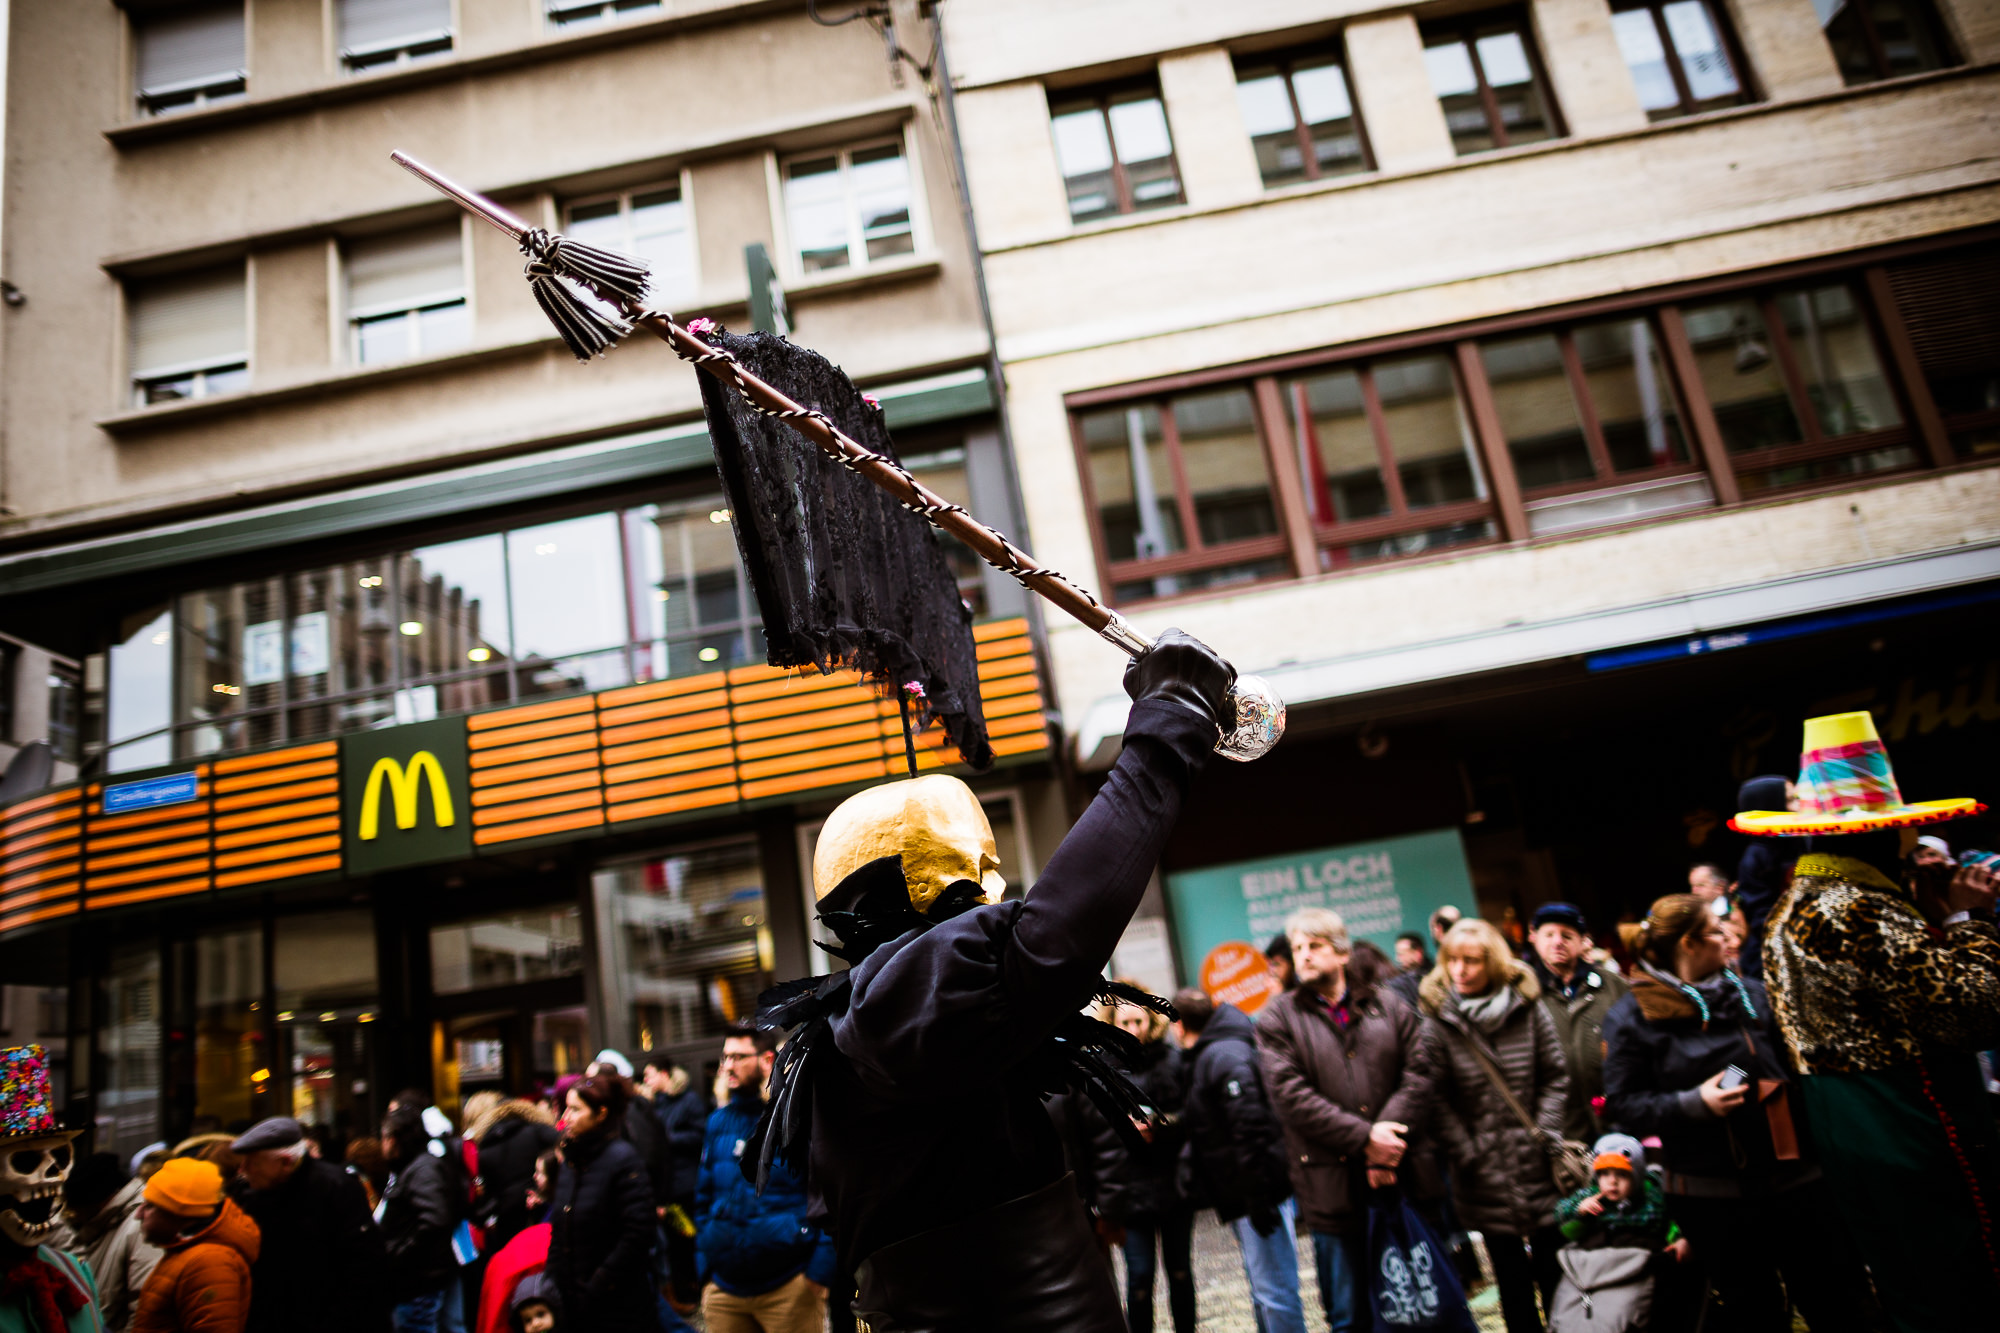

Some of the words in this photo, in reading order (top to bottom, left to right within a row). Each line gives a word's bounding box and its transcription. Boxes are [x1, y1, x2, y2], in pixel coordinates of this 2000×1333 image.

[359, 750, 454, 840] M
[1240, 867, 1299, 899] EIN
[1302, 852, 1392, 888] LOCH
